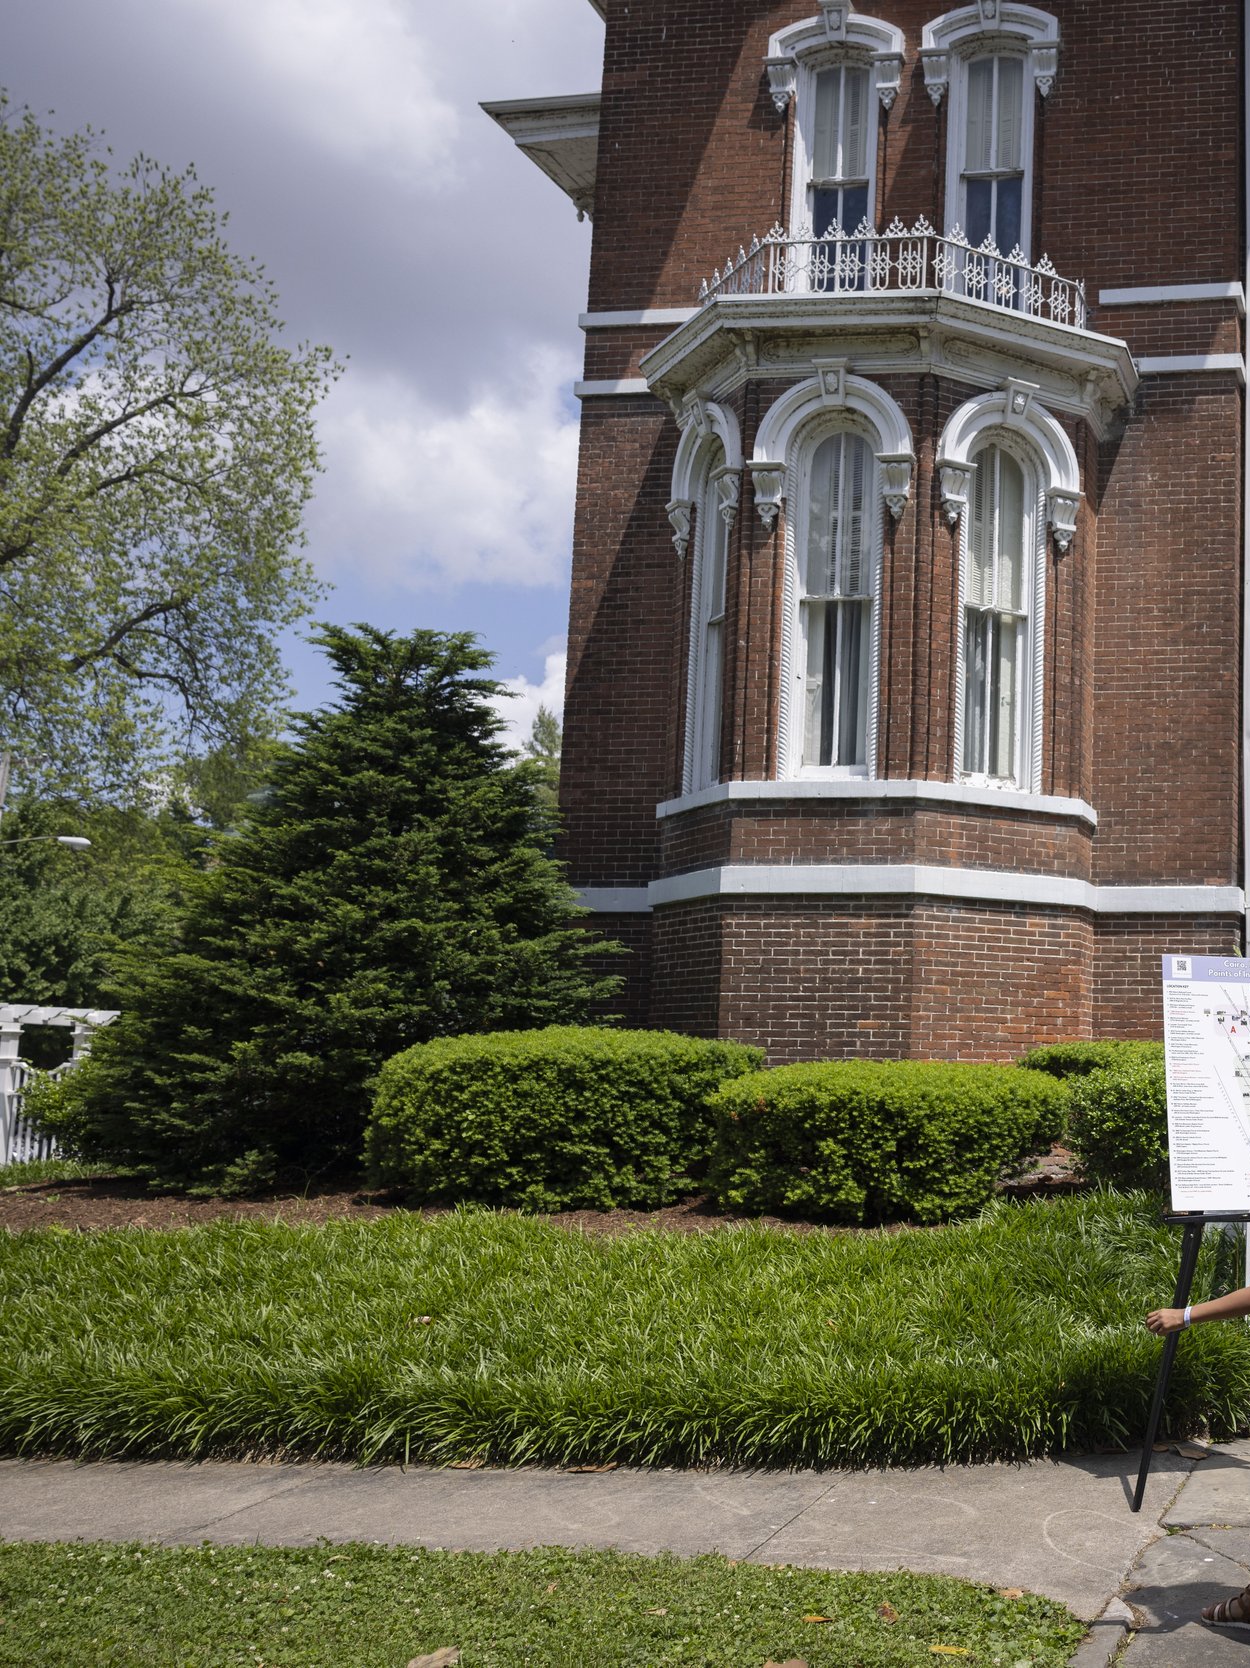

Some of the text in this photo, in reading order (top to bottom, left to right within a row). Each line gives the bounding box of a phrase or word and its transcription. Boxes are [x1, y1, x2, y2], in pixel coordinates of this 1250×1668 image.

[1208, 969, 1233, 978] Points
[1234, 969, 1242, 978] of
[1230, 1025, 1237, 1034] A
